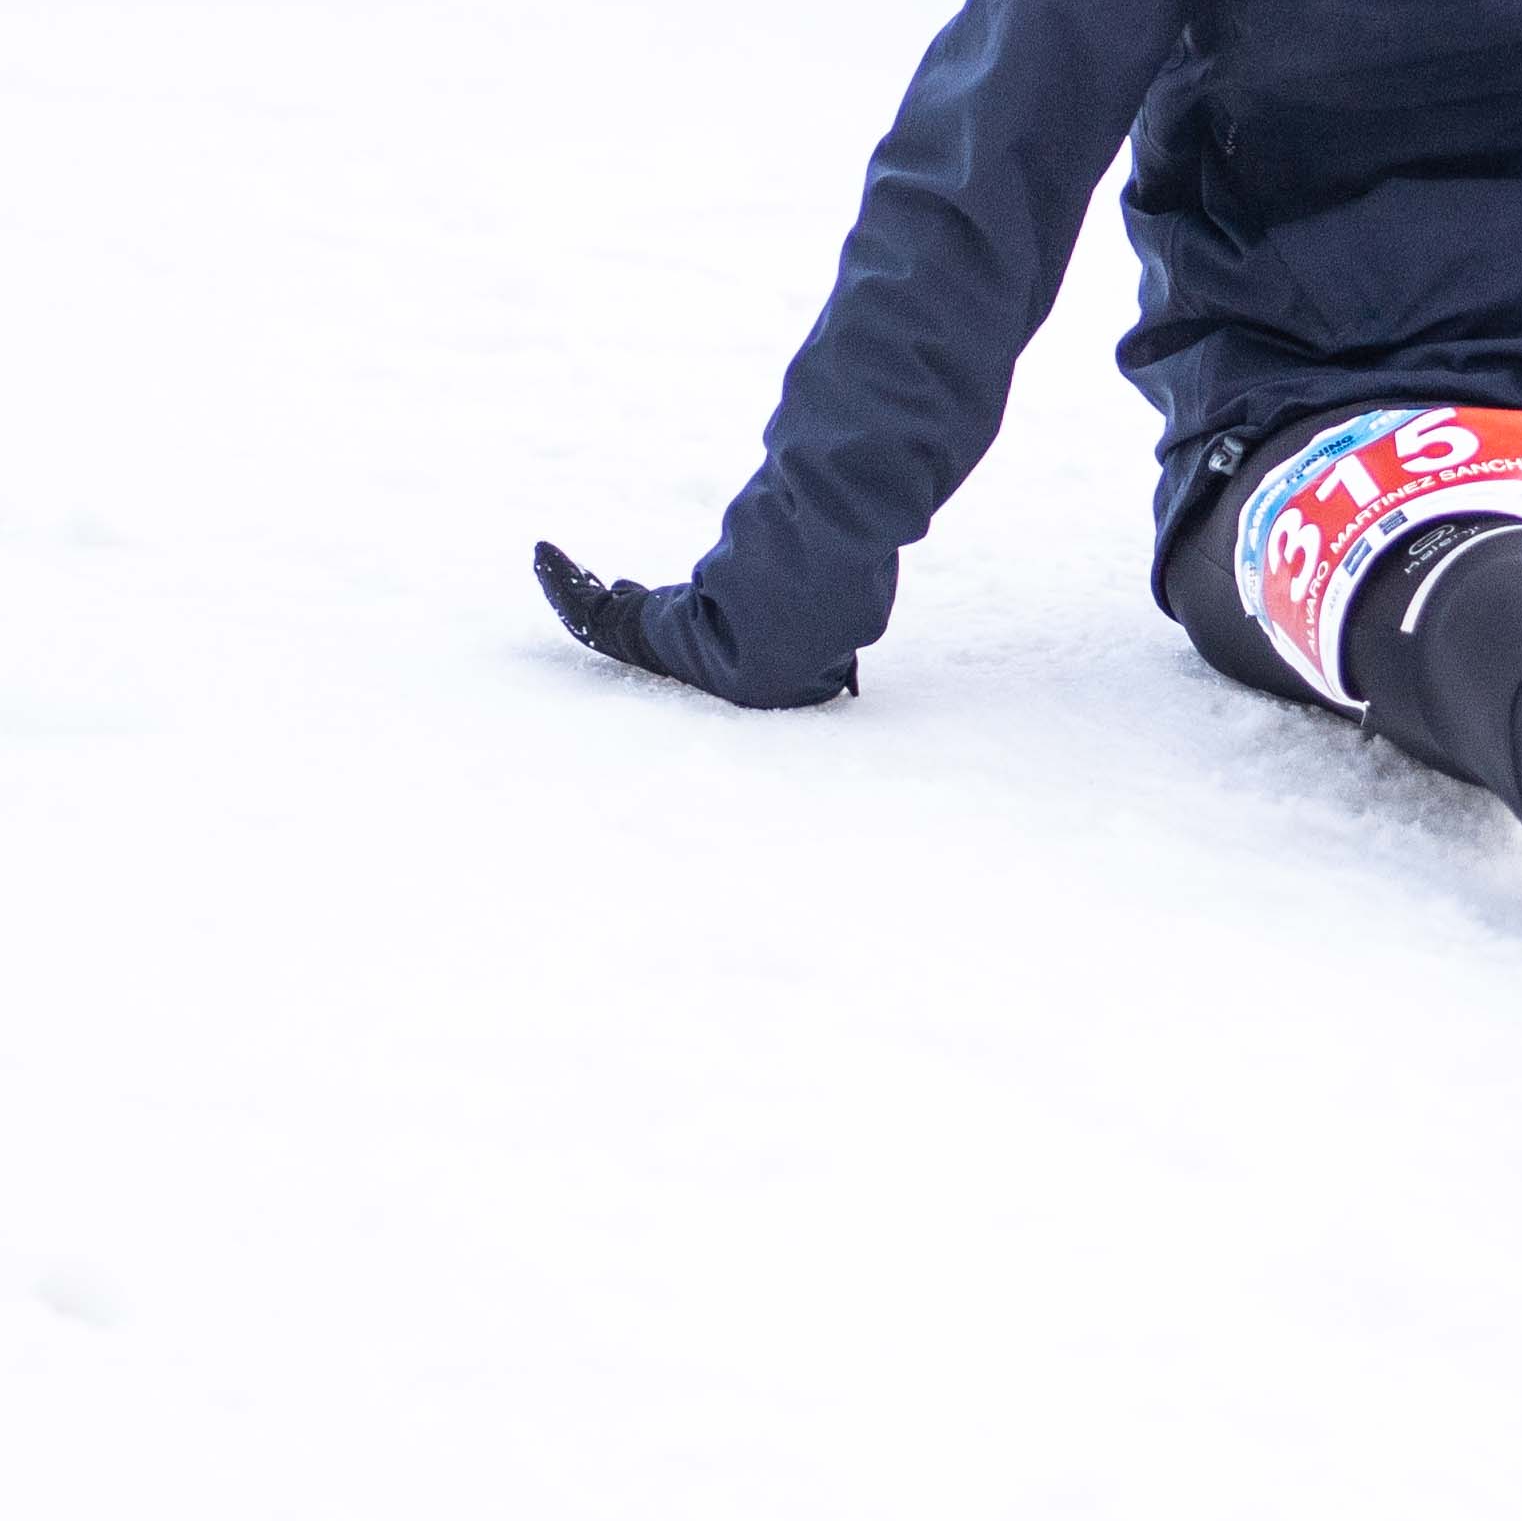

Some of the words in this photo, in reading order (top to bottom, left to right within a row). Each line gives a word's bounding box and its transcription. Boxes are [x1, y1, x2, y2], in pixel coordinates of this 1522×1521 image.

[1266, 407, 1480, 603] 315
[1304, 561, 1330, 656] ALVARO
[1329, 475, 1436, 555] MARTINEZ
